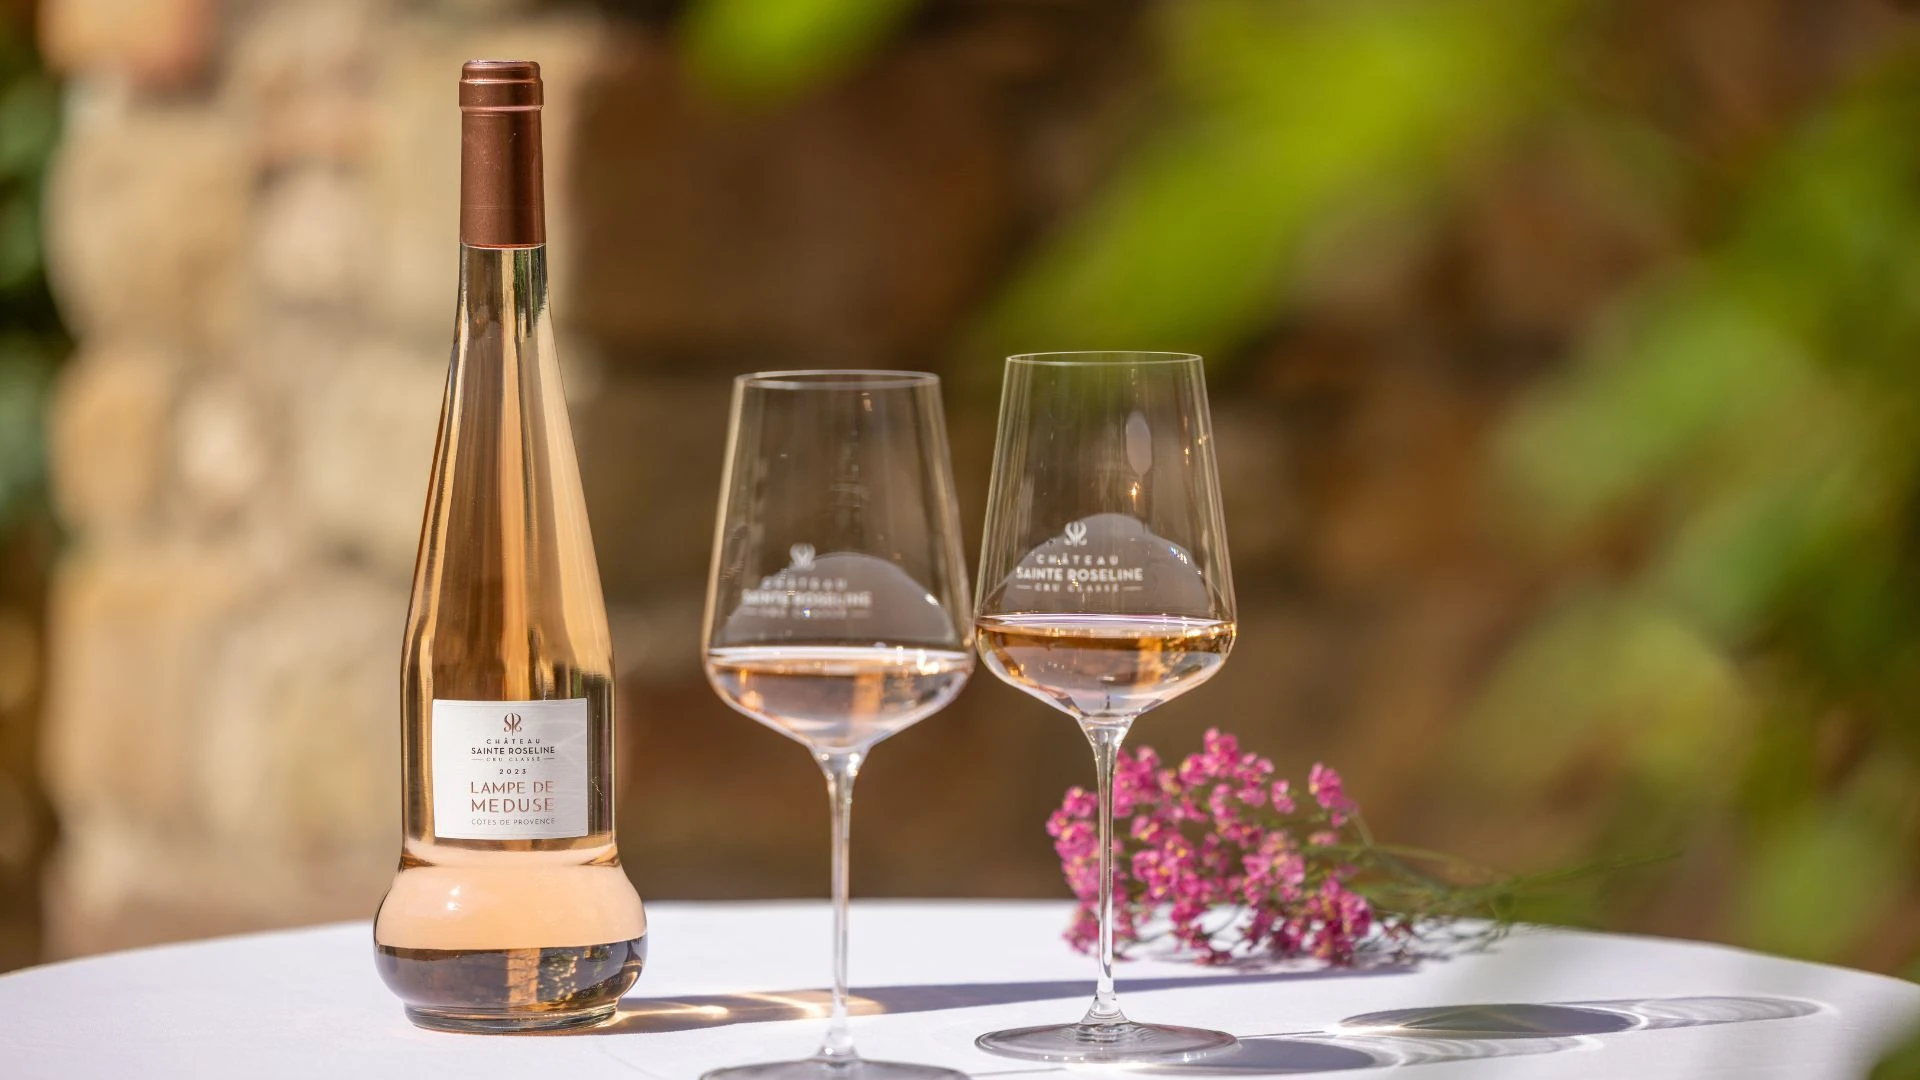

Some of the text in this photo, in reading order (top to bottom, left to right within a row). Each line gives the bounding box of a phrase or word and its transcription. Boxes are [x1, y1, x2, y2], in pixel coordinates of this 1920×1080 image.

[1016, 567, 1143, 582] SAINTE ROSELINE
[471, 746, 555, 755] SAINTE ROSELINE
[471, 780, 554, 794] LAMPE DE
[471, 798, 555, 813] MEDUSE
[471, 818, 497, 826] CÔTES
[513, 817, 555, 826] PROVENCE
